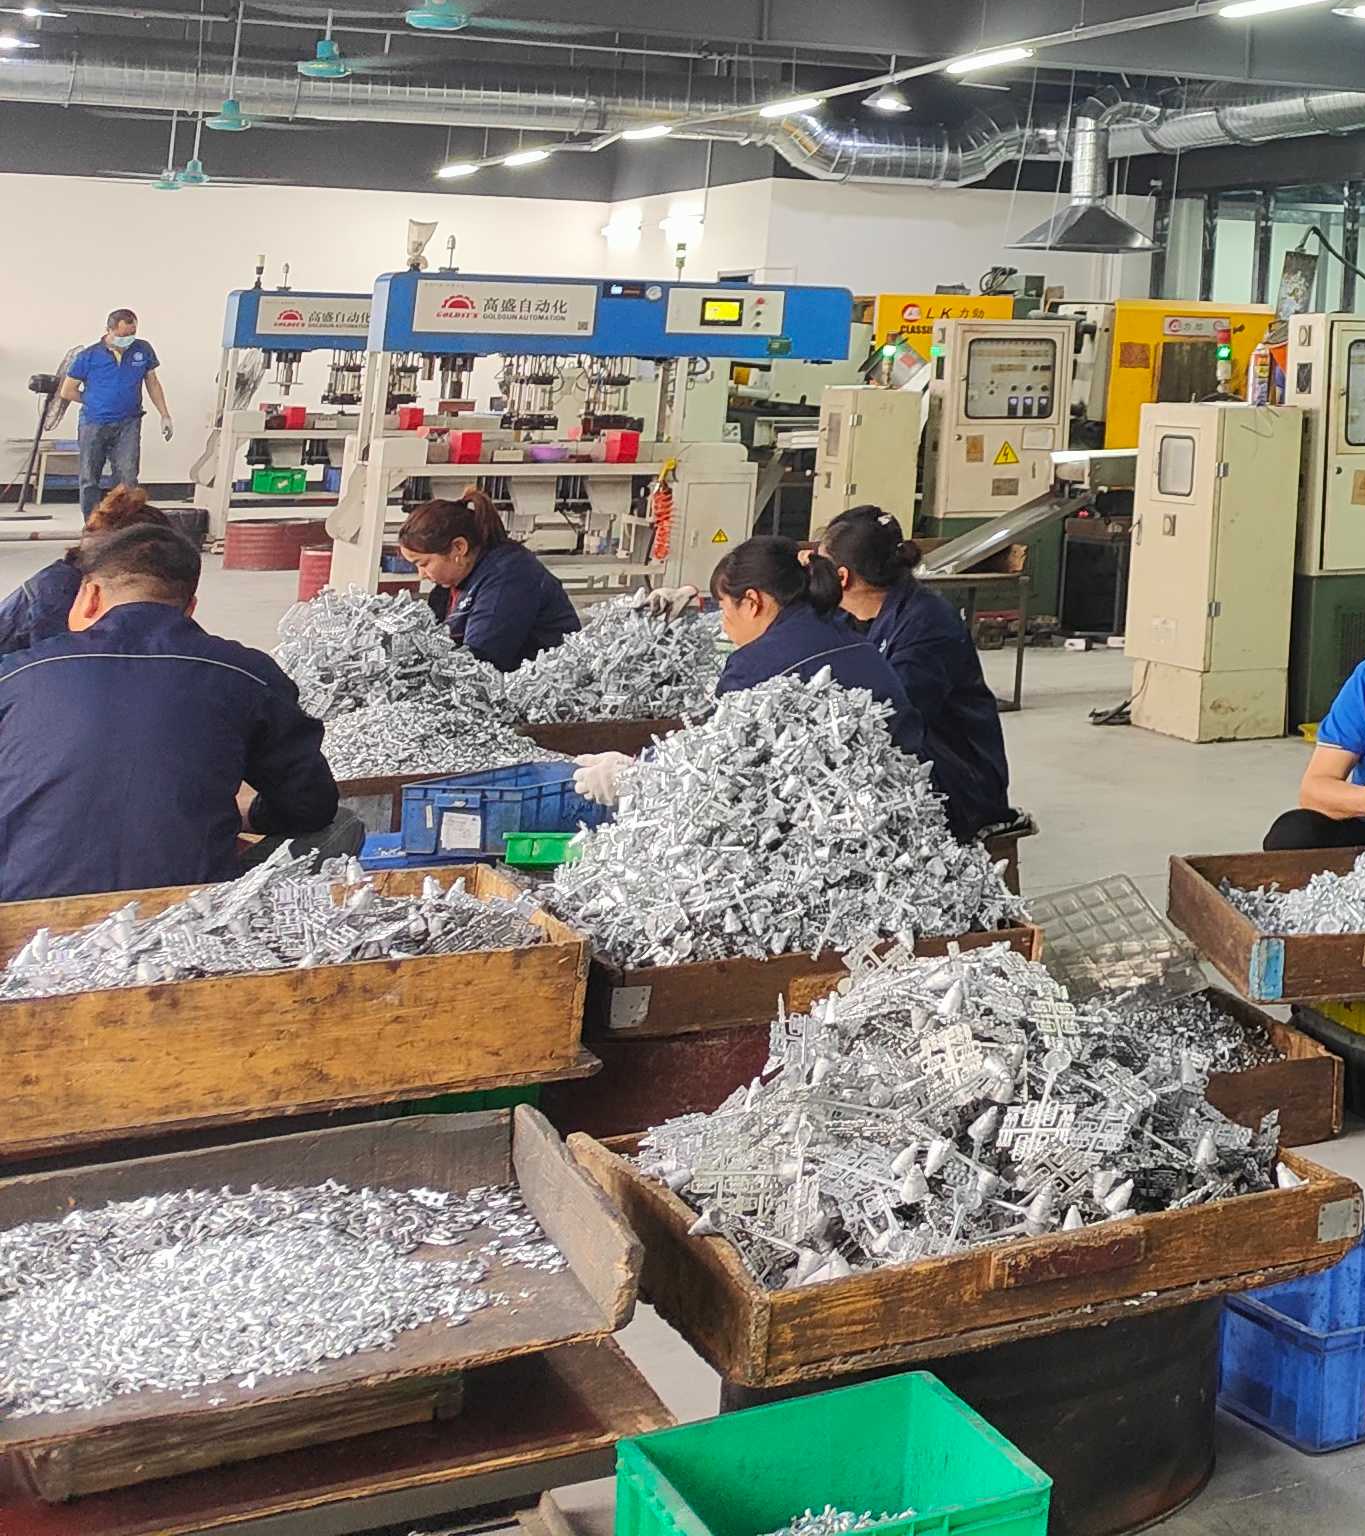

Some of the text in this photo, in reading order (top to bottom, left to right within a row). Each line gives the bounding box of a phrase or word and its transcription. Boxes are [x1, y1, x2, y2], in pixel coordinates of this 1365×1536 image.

[483, 297, 568, 314] 高盛自动化
